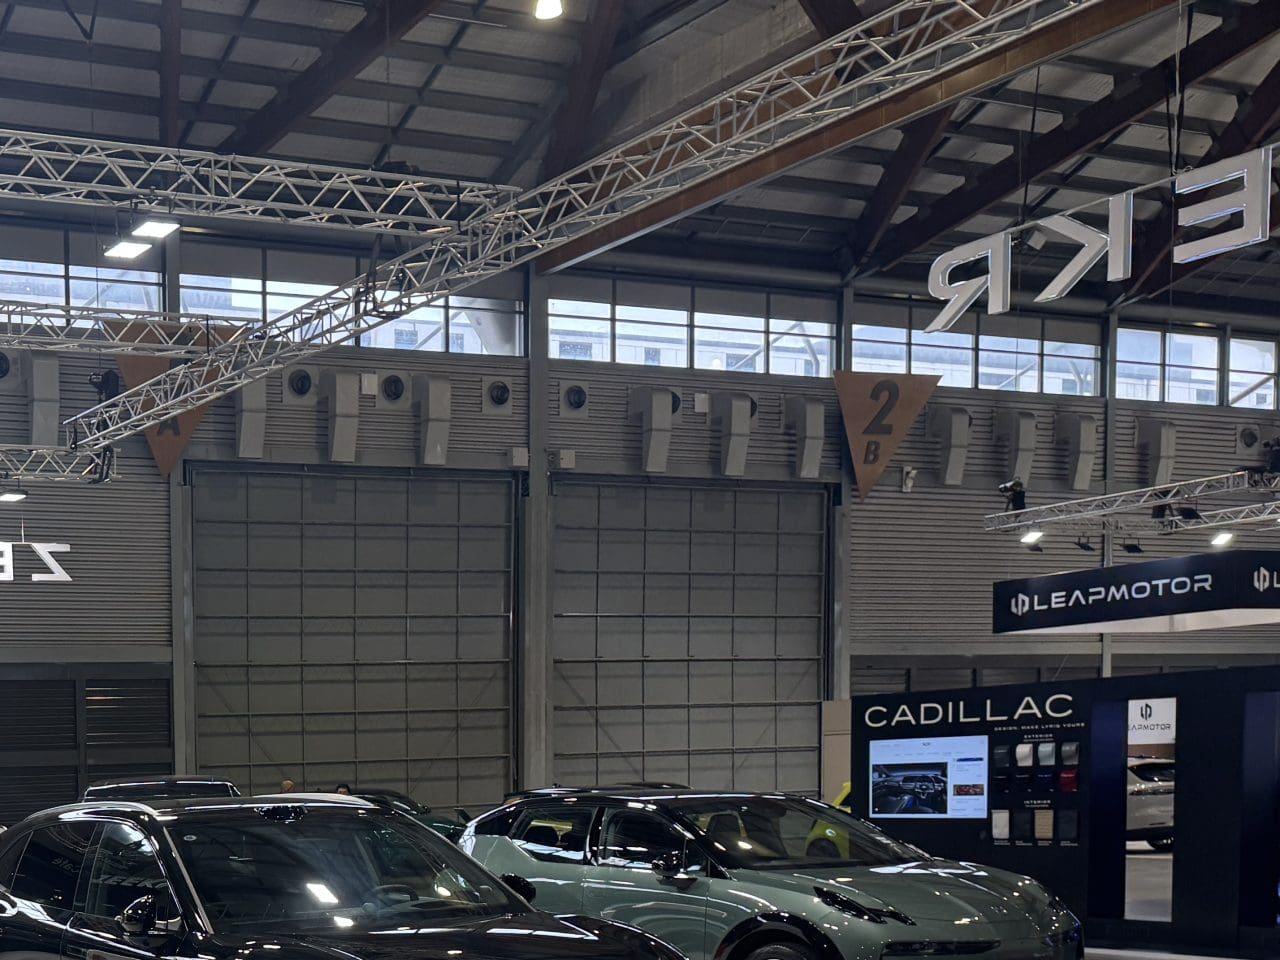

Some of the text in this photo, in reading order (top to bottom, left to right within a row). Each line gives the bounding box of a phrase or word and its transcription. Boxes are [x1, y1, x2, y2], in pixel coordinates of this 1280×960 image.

[862, 380, 899, 435] 2
[863, 441, 880, 465] B
[1033, 574, 1213, 611] LEAPMOTOR
[864, 693, 1073, 728] CADILLAC
